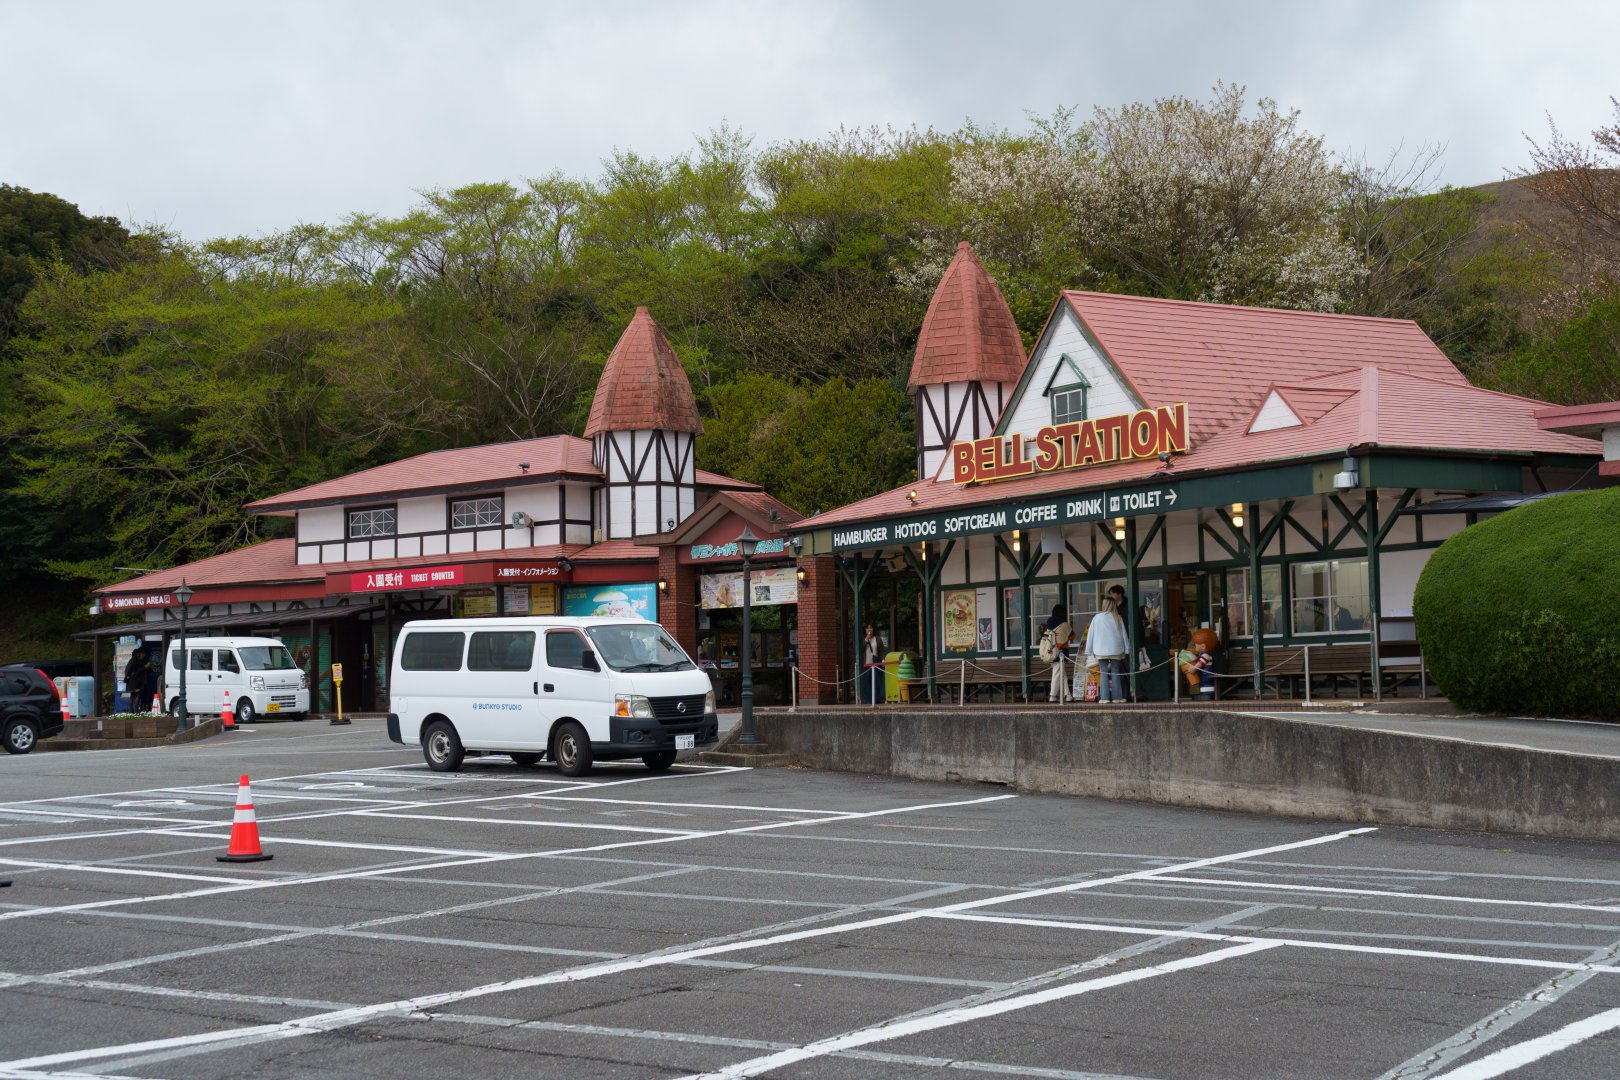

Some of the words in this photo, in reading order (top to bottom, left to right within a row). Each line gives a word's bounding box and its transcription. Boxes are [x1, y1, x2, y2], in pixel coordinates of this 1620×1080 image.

[952, 431, 1034, 485] BELL
[1035, 402, 1189, 472] STATION
[1122, 490, 1162, 510] TOILET
[833, 526, 888, 547] HAMBURGER
[894, 520, 937, 539] HOTDOG
[944, 511, 1007, 533] SOFTCREAM
[1014, 504, 1058, 524] COFFEE
[1066, 498, 1102, 518] DRINK
[366, 572, 403, 588] 入園受付
[410, 573, 429, 582] TICKET
[431, 571, 455, 580] COUNTER
[114, 597, 144, 608] SMOKING
[146, 595, 164, 605] AREA
[501, 703, 523, 711] STUDIO
